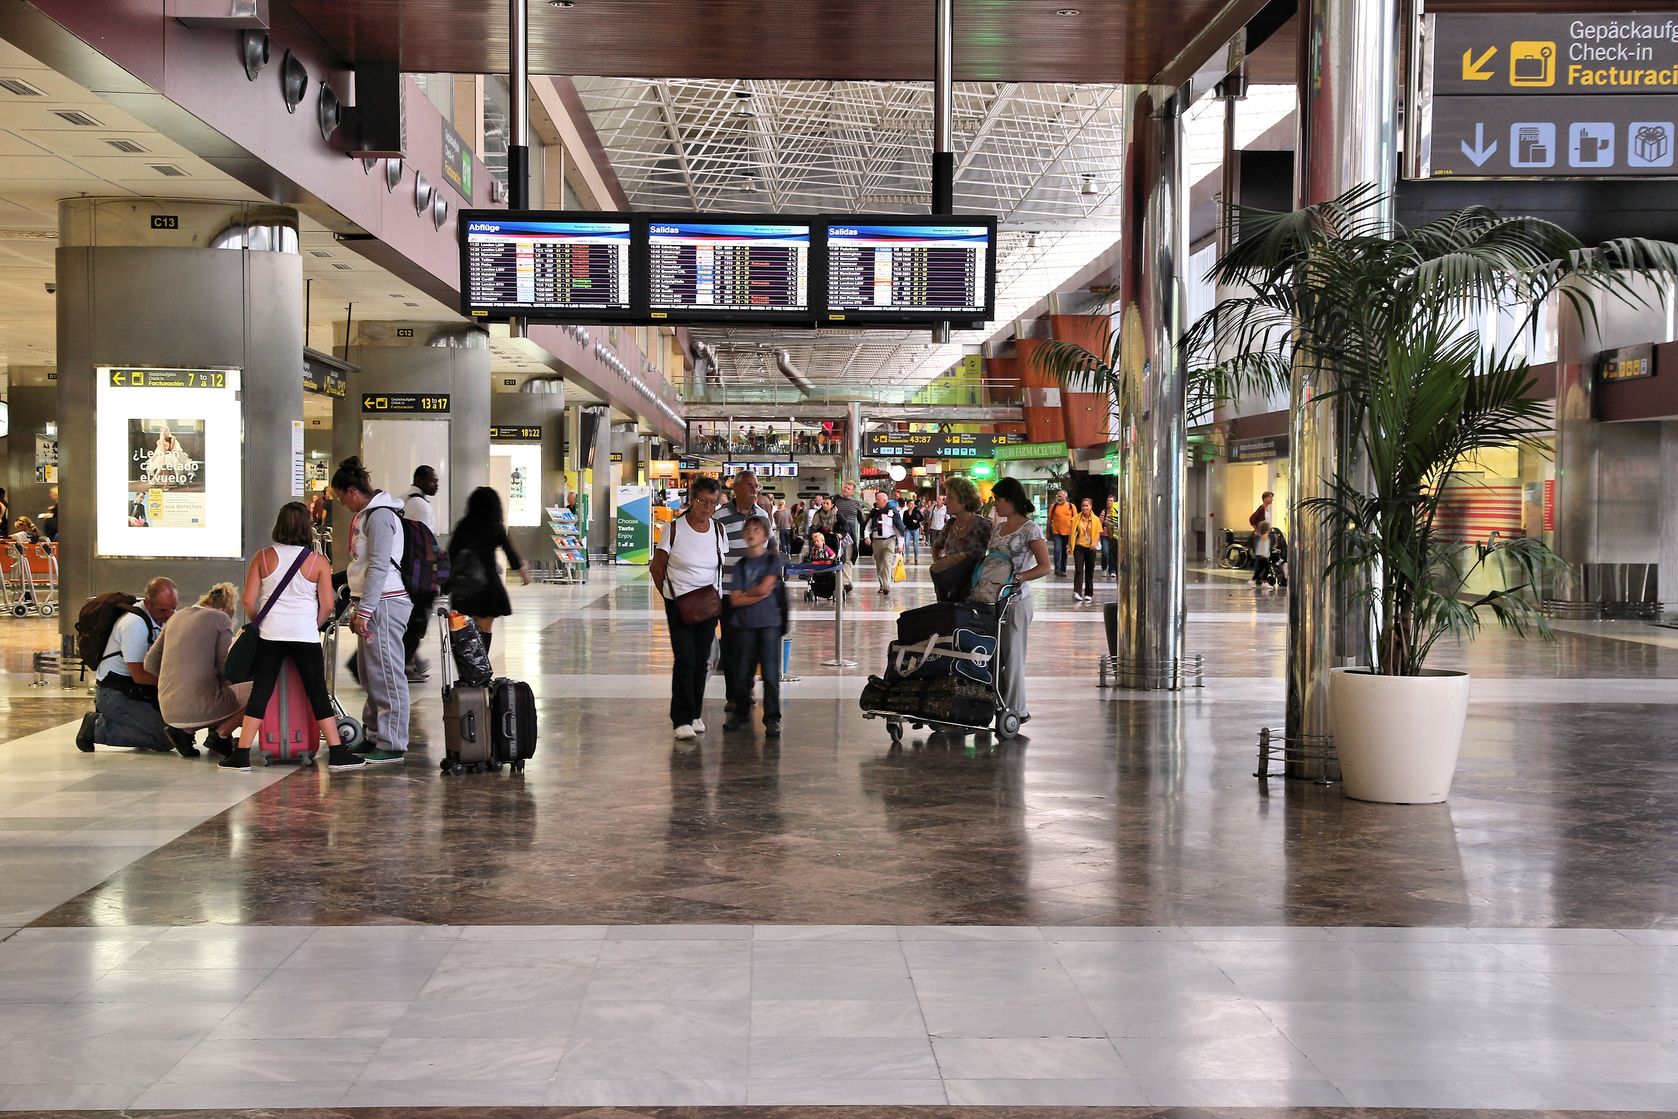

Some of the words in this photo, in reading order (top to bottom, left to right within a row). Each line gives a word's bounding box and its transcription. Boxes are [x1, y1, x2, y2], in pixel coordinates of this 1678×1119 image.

[1569, 42, 1653, 60] Check-in
[1568, 64, 1678, 85] Facturaci
[154, 218, 175, 227] C13
[469, 224, 500, 232] Abflüge
[188, 373, 195, 386] 7
[211, 374, 223, 387] 12
[422, 398, 431, 409] 13
[438, 398, 447, 409] 17
[522, 429, 528, 437] 18
[533, 429, 540, 437] 22
[133, 448, 154, 461] ¿Le
[140, 473, 150, 482] el
[154, 472, 194, 483] vuelo?
